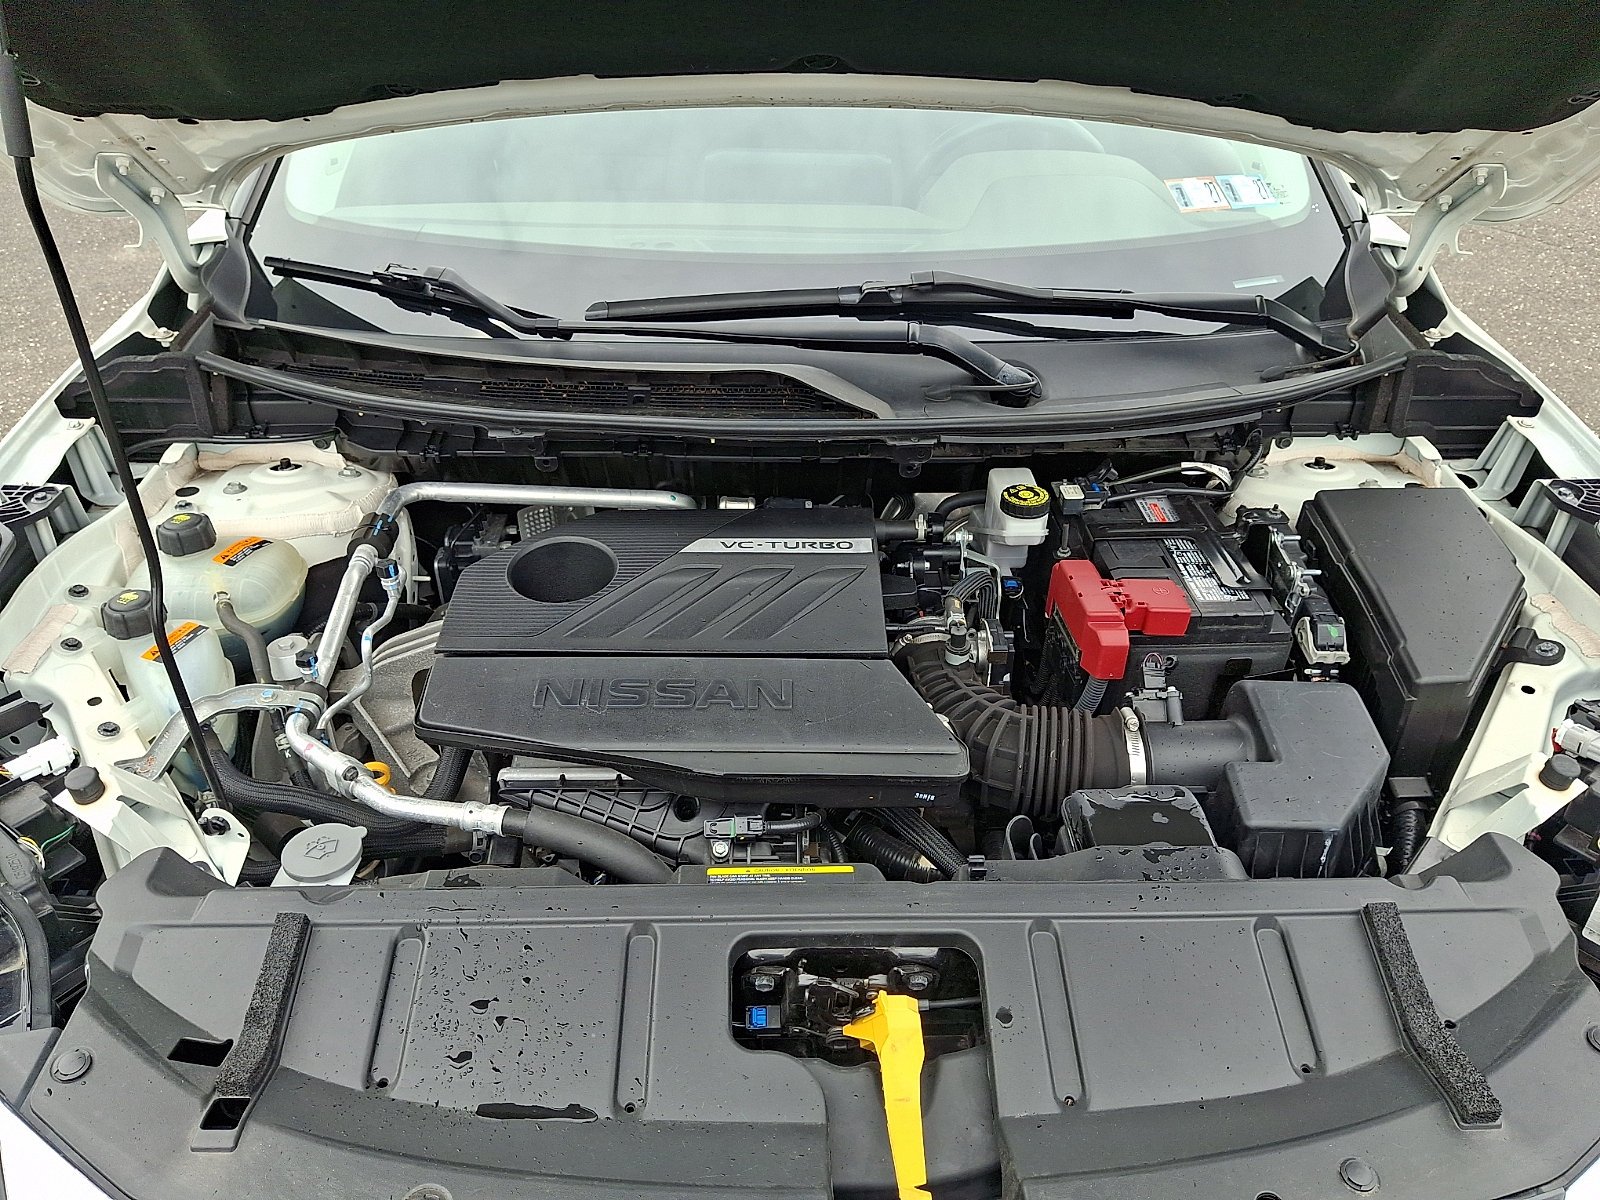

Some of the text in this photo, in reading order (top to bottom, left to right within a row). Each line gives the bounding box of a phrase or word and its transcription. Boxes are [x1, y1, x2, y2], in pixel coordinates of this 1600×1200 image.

[719, 540, 854, 550] VC-TURBO
[532, 678, 794, 710] NISSAN
[284, 749, 292, 758] K
